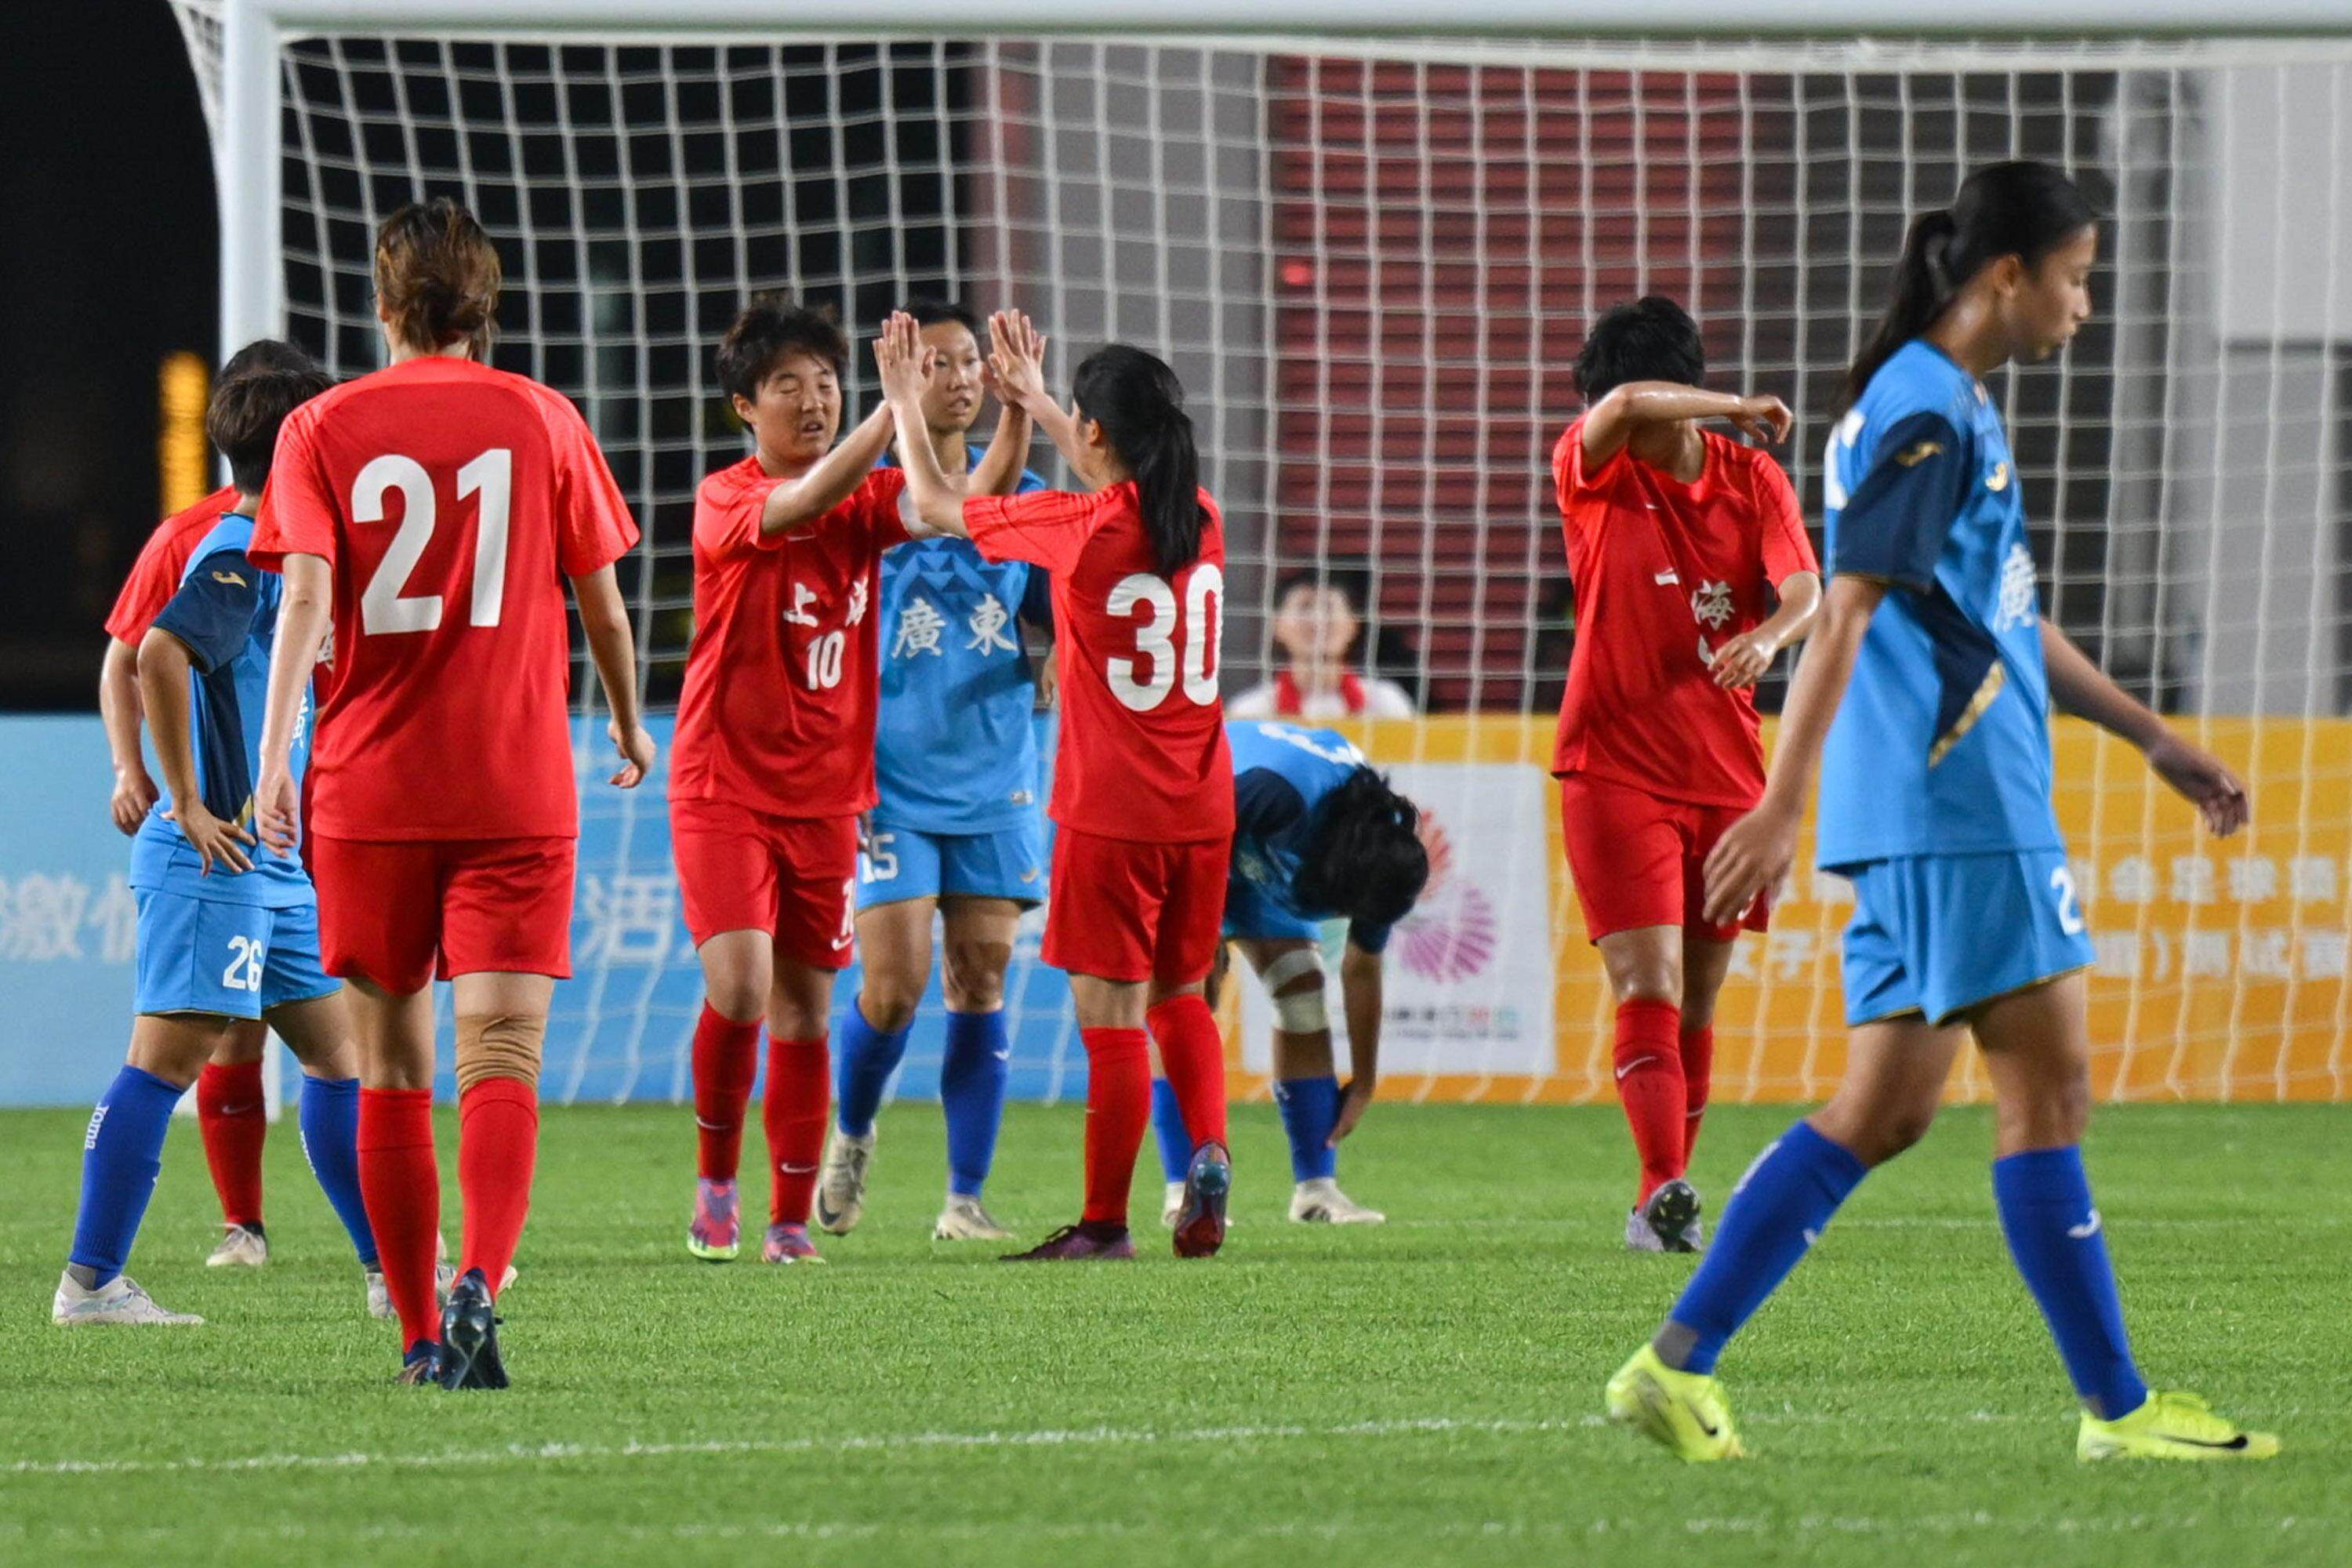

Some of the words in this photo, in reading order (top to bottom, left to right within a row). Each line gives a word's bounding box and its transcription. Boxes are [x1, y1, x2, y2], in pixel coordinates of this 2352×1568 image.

[350, 448, 512, 636] 21
[891, 593, 1018, 659] 廣東
[1105, 563, 1224, 712] 30
[807, 630, 845, 690] 10
[862, 833, 899, 884] 15
[222, 935, 263, 992] 26
